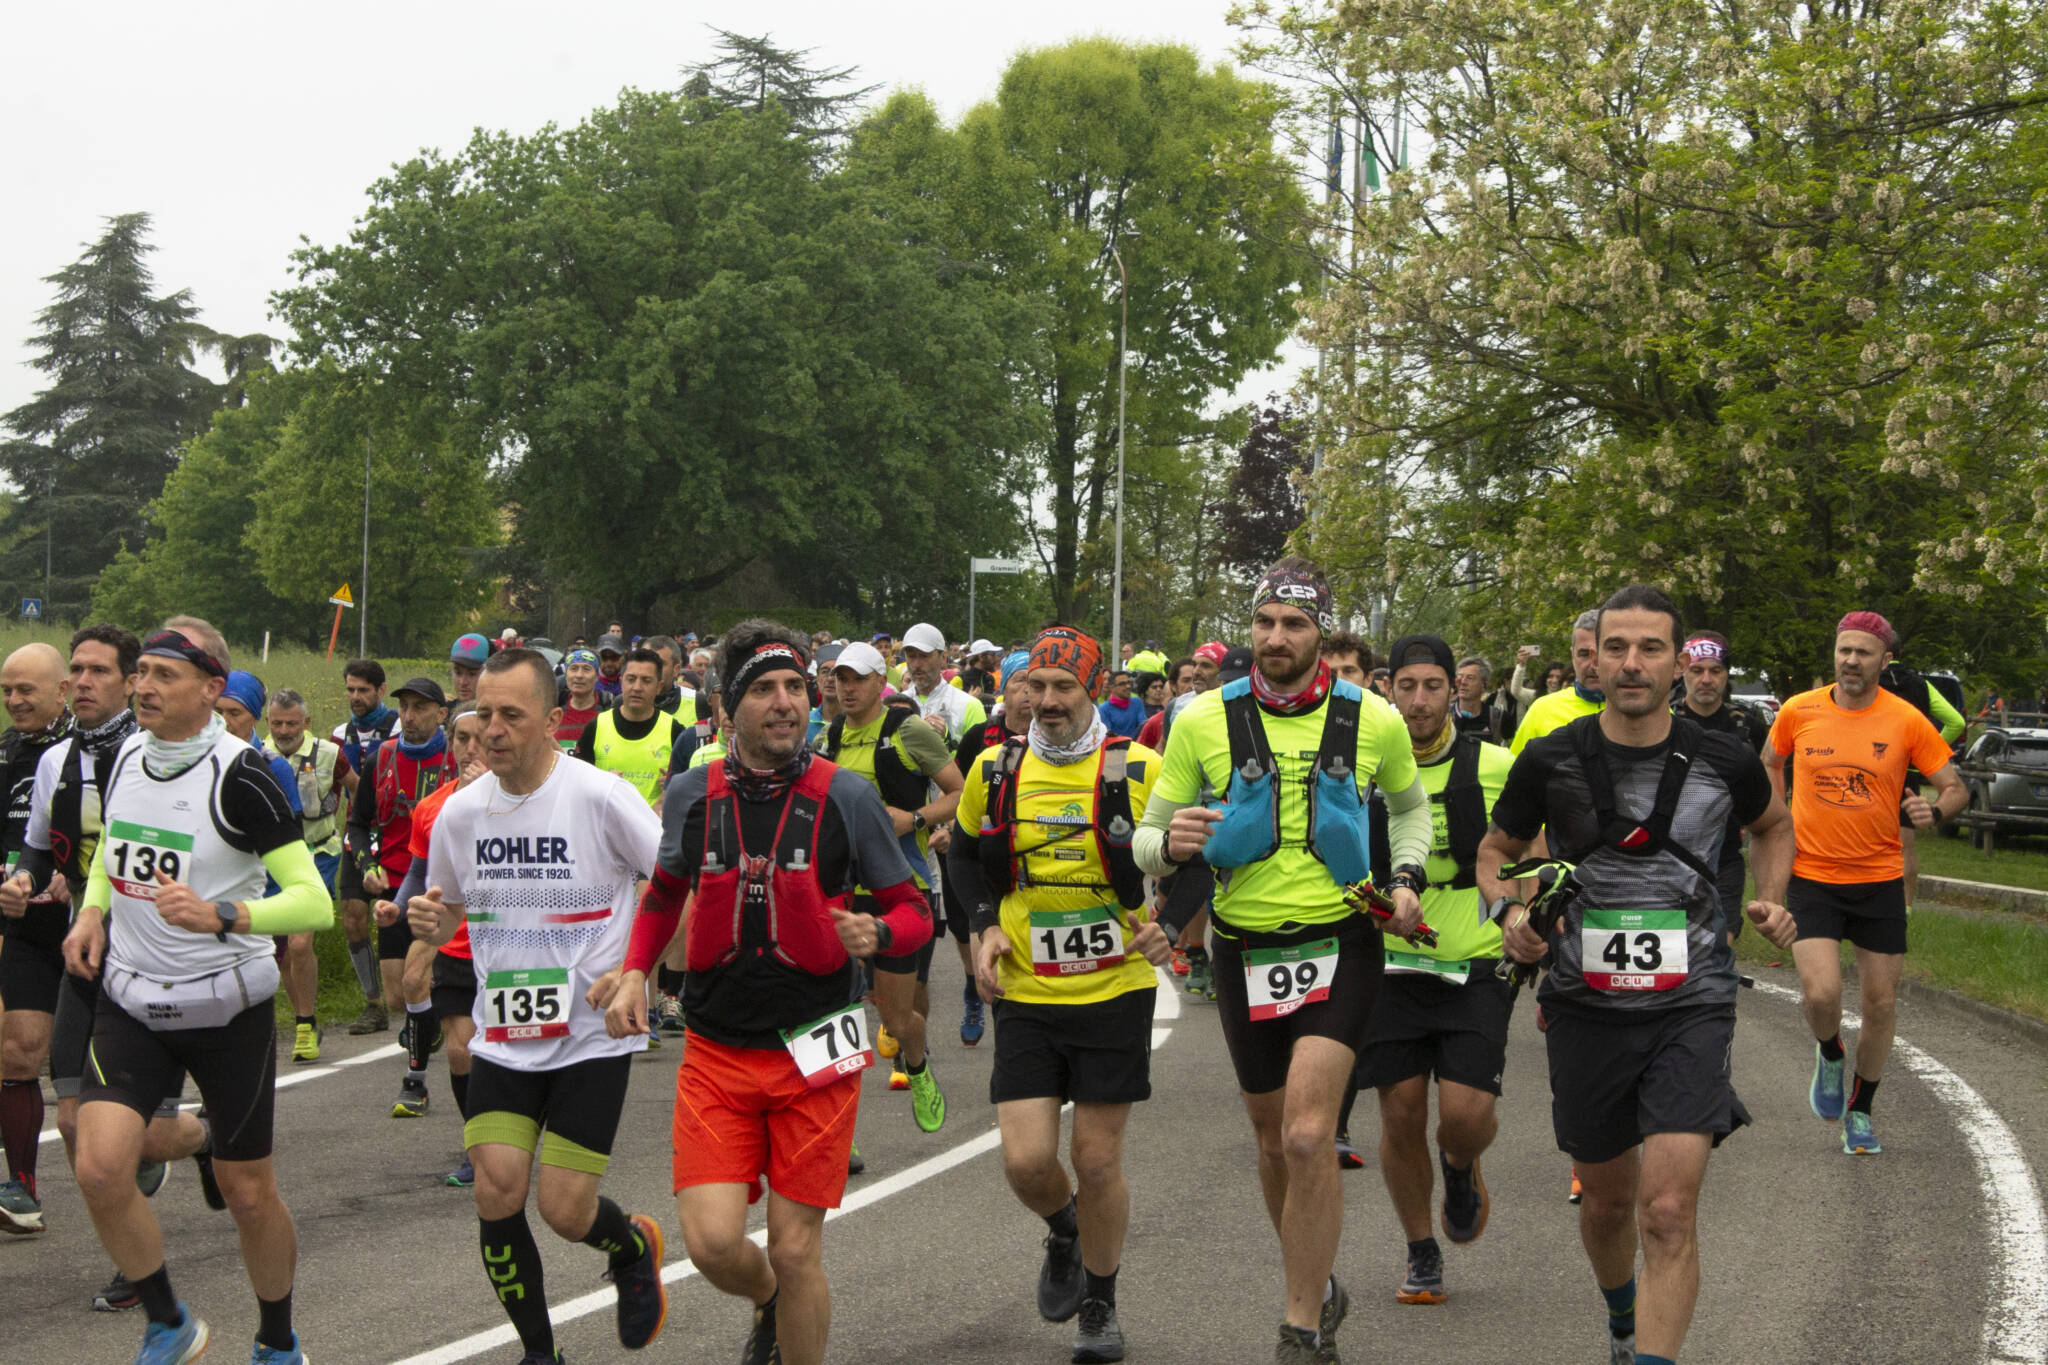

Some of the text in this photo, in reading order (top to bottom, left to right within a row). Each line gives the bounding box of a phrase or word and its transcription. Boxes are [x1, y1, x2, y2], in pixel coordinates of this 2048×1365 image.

[113, 841, 181, 882] 139
[476, 837, 569, 865] KOHLER
[484, 868, 517, 880] POWER.
[518, 868, 543, 880] SINCE
[545, 869, 573, 880] 1920.
[1040, 922, 1115, 961] 145
[1602, 932, 1663, 971] 43
[1267, 961, 1319, 1001] 99
[492, 987, 560, 1025] 135
[810, 1014, 860, 1061] 70
